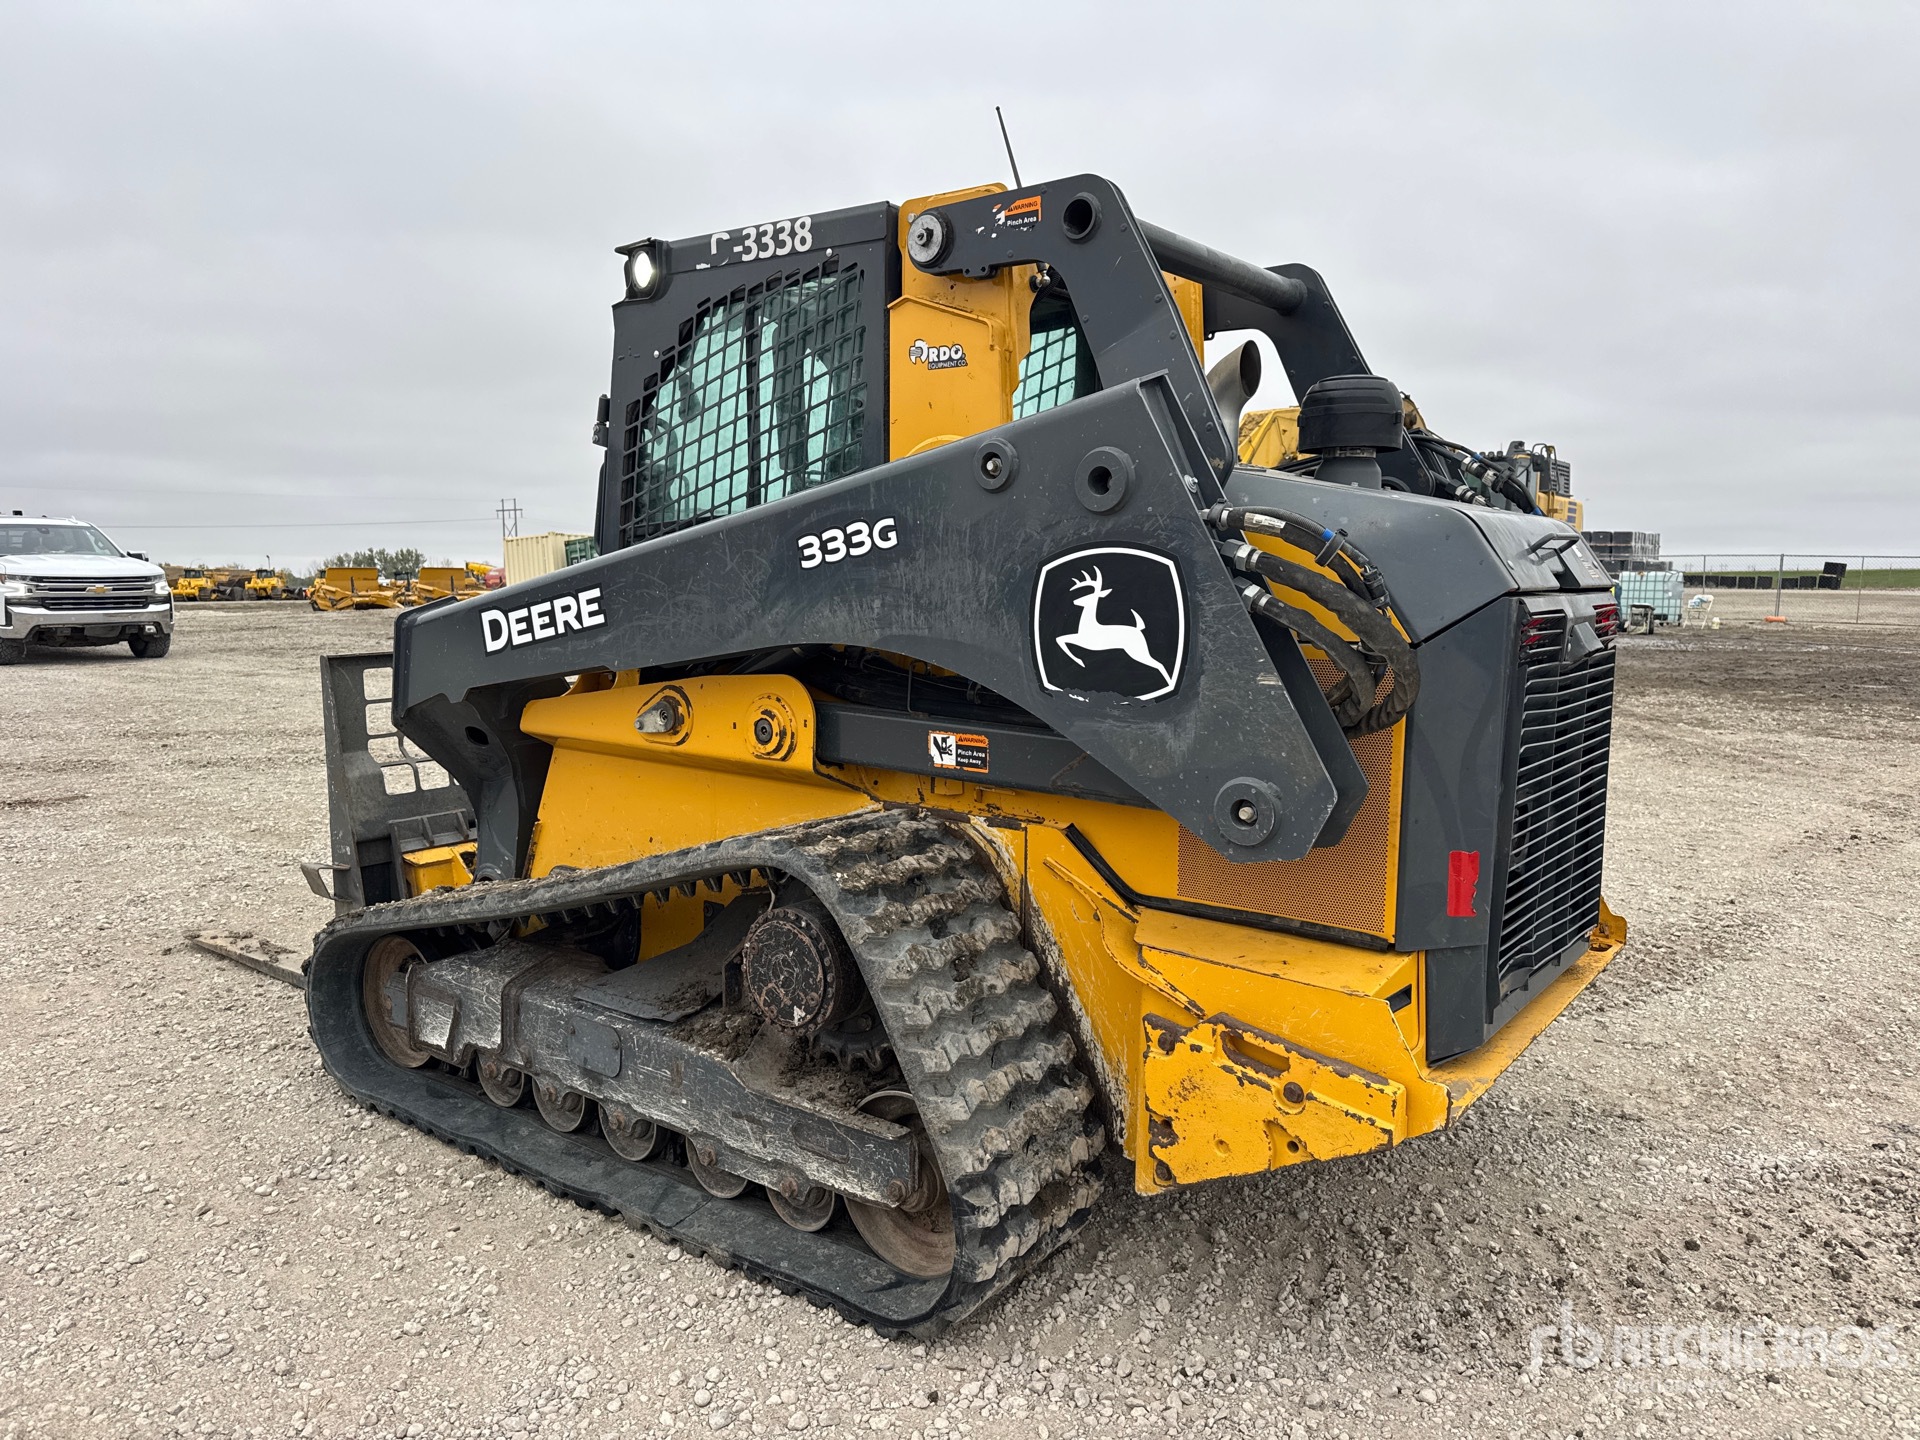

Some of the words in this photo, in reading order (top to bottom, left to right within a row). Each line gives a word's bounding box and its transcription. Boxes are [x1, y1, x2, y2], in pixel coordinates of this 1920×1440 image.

[1012, 200, 1038, 211] WARNING
[1006, 219, 1023, 227] Pinch
[1023, 216, 1037, 224] Area
[798, 518, 898, 569] 333G
[481, 587, 605, 653] DEERE
[963, 736, 987, 745] WARNING
[957, 748, 972, 756] Pinch
[972, 749, 986, 758] Area
[969, 758, 982, 766] Away
